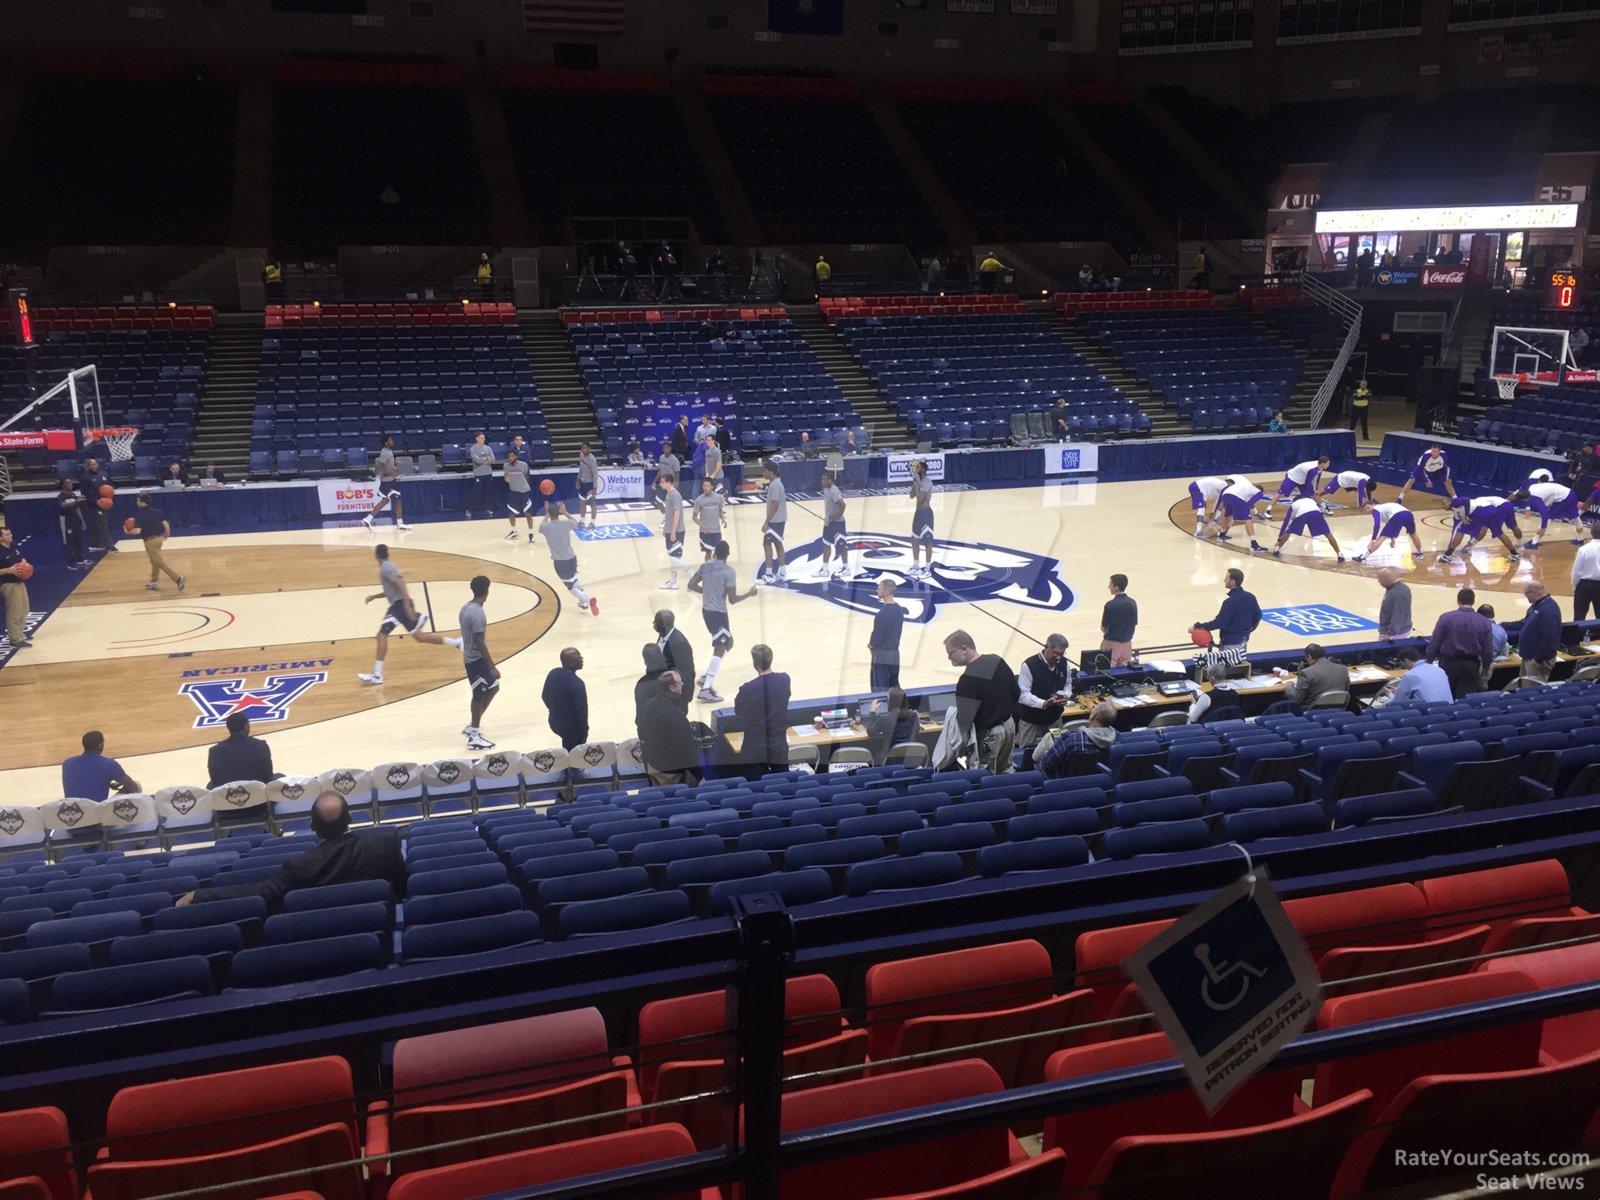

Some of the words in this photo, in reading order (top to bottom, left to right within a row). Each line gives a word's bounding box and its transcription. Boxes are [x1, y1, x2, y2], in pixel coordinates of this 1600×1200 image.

[1393, 271, 1418, 279] Webster
[1561, 287, 1572, 307] 0
[890, 461, 908, 472] WTIC
[607, 475, 642, 484] Webster
[336, 489, 375, 500] BOB'S
[608, 485, 629, 493] Bank
[337, 502, 375, 511] FURNITURE
[180, 658, 335, 679] AMERICAN
[1205, 1015, 1274, 1075] RESERVED
[1275, 991, 1303, 1020] ADA
[1204, 1044, 1260, 1092] PATRON
[1260, 998, 1313, 1048] SEATING
